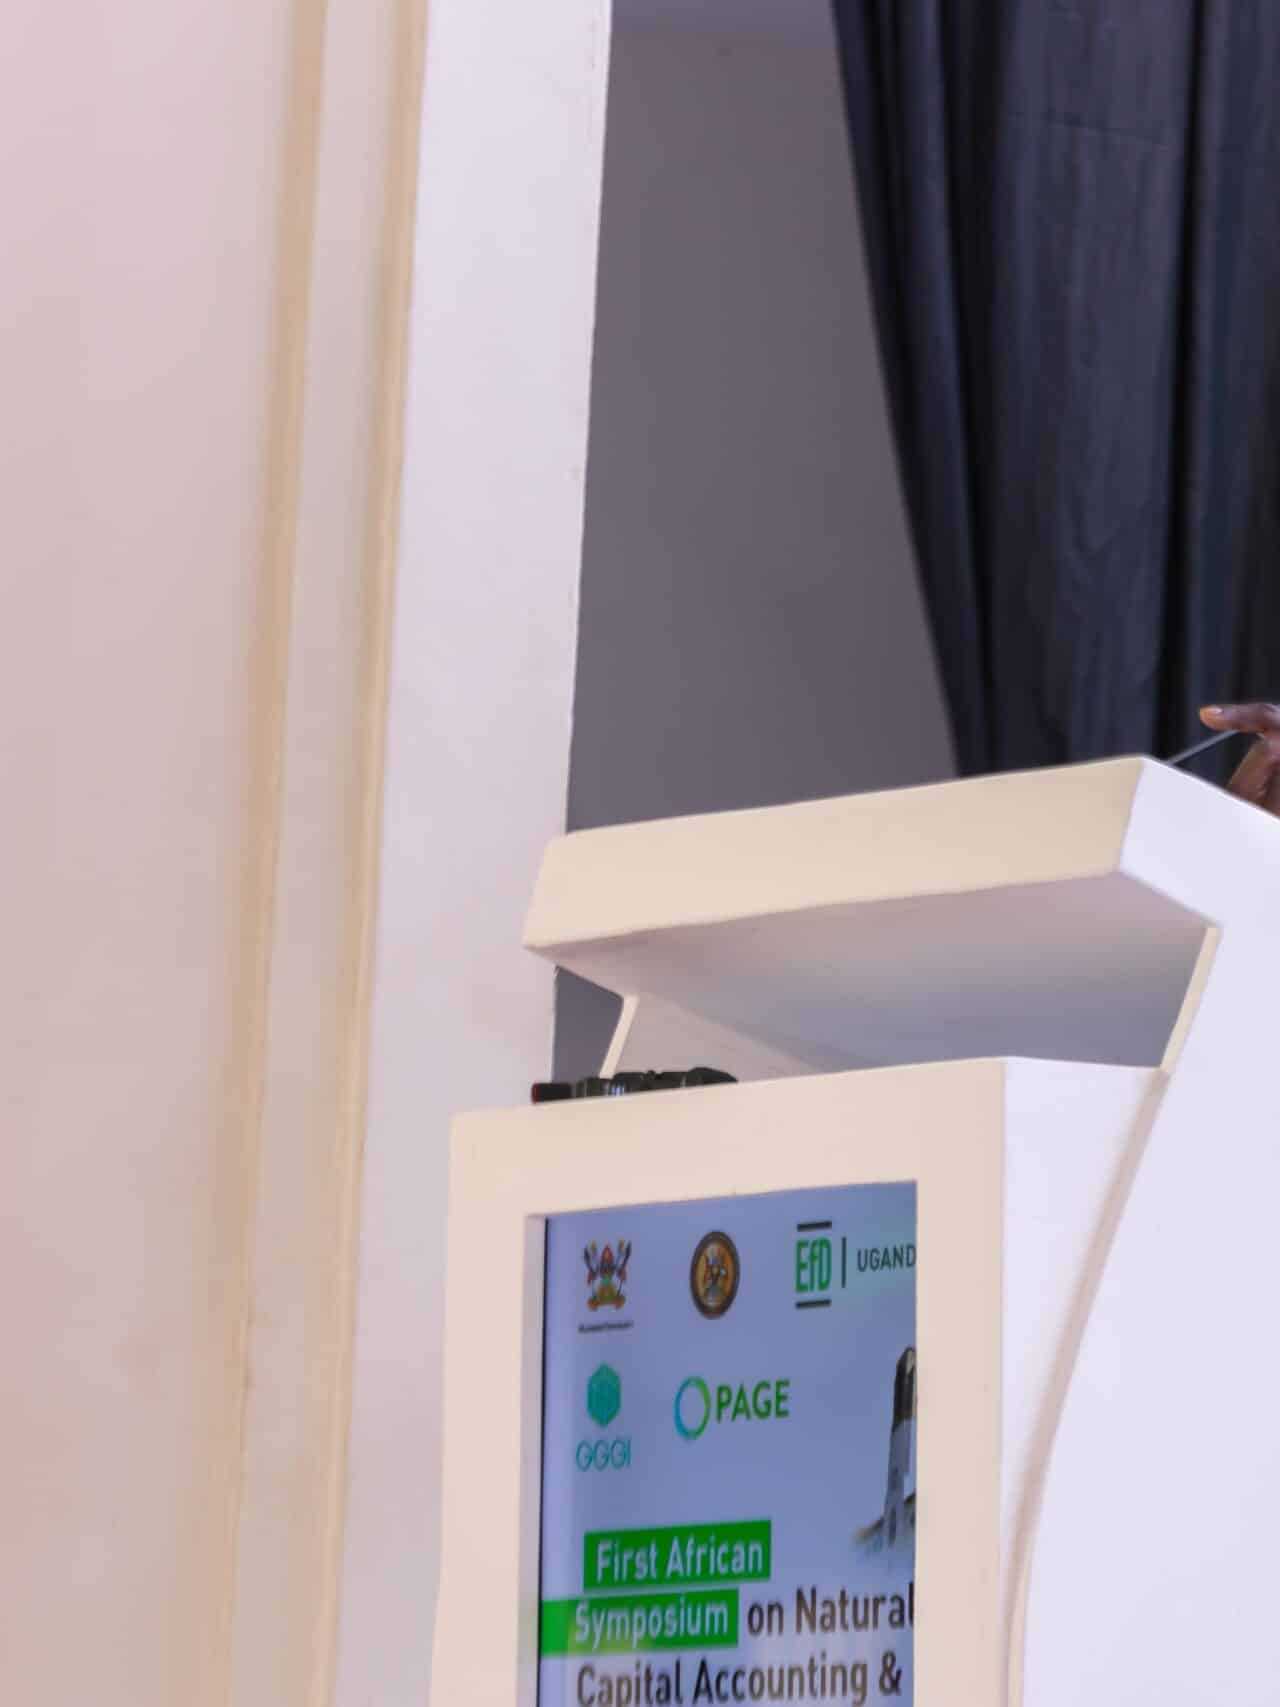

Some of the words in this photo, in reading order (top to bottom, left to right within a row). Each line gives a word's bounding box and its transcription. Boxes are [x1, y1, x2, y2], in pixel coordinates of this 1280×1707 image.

[715, 1379, 790, 1423] PAGE
[575, 1438, 632, 1472] GGGI
[596, 1538, 658, 1584] First
[665, 1532, 763, 1578] African
[574, 1596, 729, 1650] Symposium
[746, 1601, 785, 1637] on
[576, 1658, 682, 1707] Capital
[692, 1648, 869, 1707] Accounting
[878, 1649, 902, 1696] &
